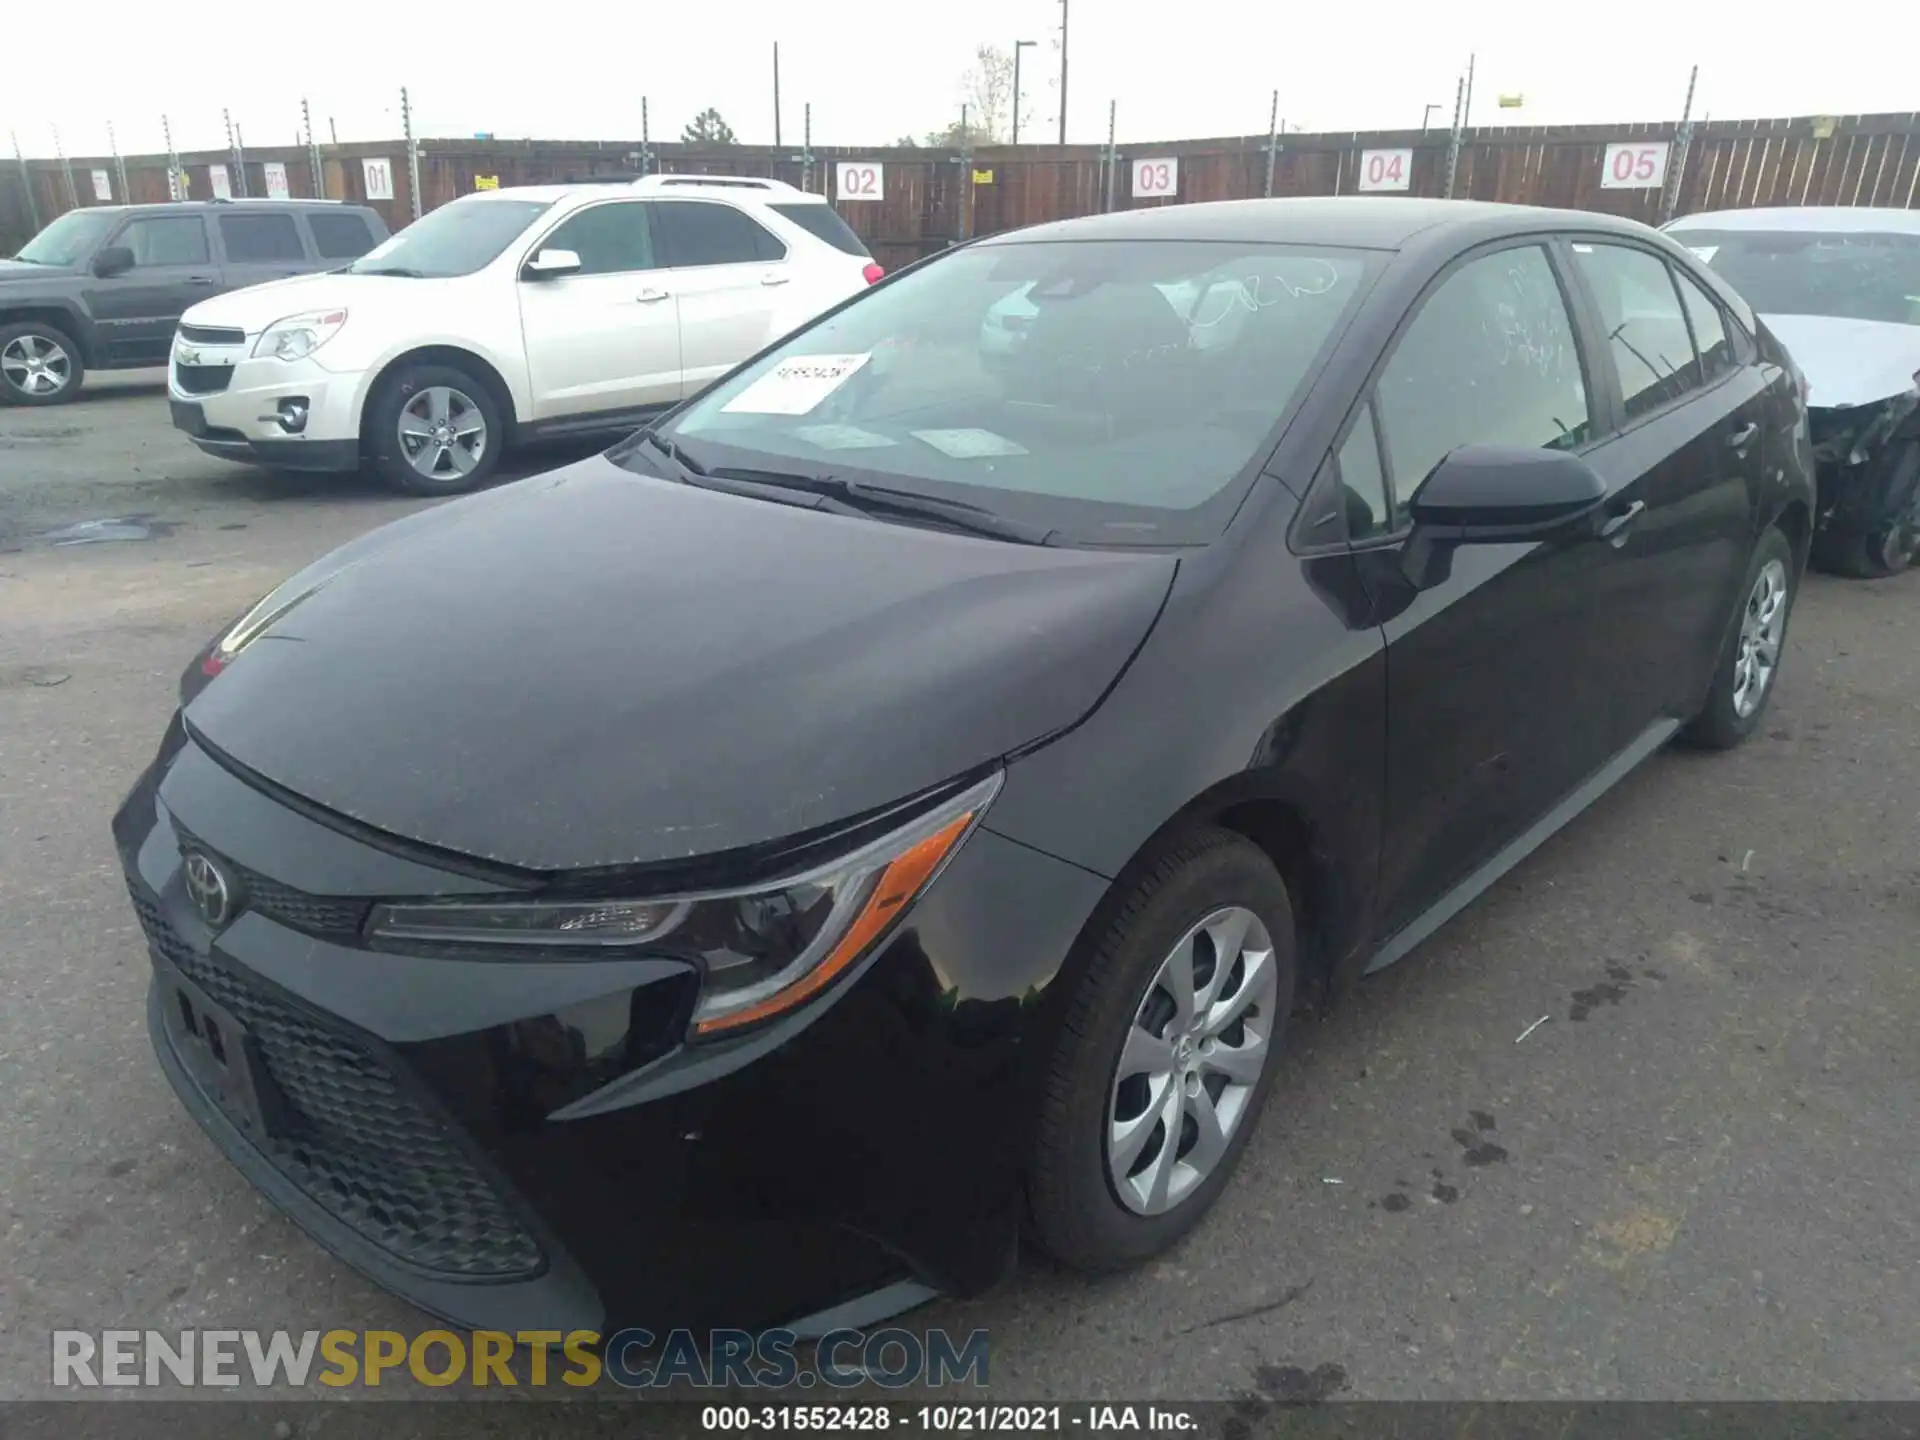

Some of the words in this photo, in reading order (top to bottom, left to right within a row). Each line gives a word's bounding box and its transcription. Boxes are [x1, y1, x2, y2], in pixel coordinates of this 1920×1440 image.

[1140, 164, 1170, 190] 03
[1369, 155, 1402, 183] 04
[1613, 149, 1657, 180] 05
[367, 164, 387, 194] 01
[845, 168, 876, 194] 02
